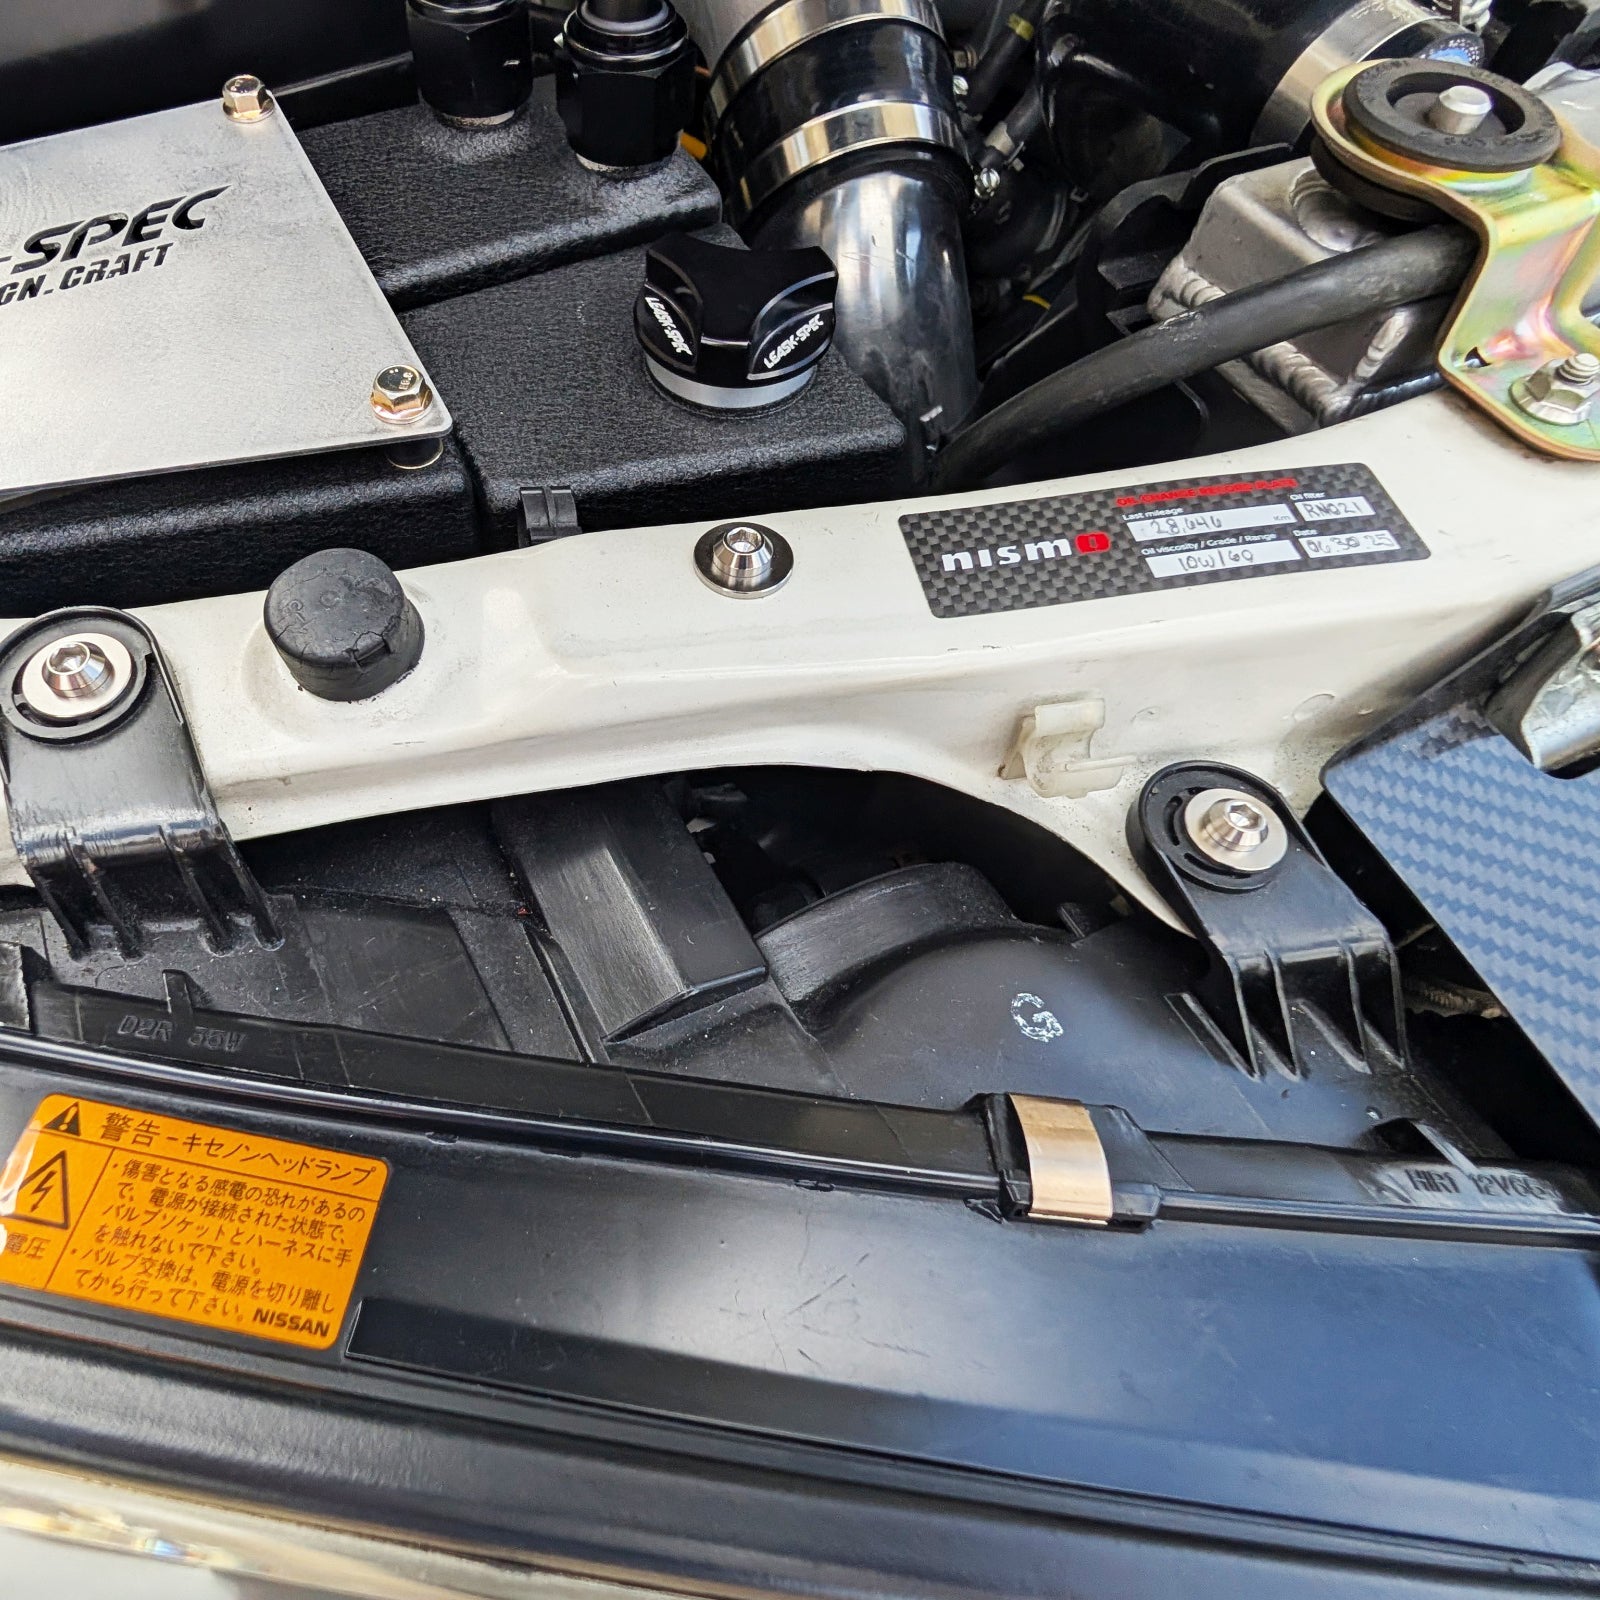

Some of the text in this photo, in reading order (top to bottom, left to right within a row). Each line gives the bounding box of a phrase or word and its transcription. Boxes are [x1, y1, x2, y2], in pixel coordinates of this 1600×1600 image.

[763, 313, 824, 369] LEASK-SPEC
[1122, 507, 1184, 521] Last mileage
[941, 531, 1112, 572] nismo
[1141, 547, 1156, 556] Oil
[1156, 541, 1199, 554] viscosity
[1206, 536, 1237, 548] Grade
[1244, 532, 1278, 543] Range
[252, 1306, 332, 1338] NISSAN
